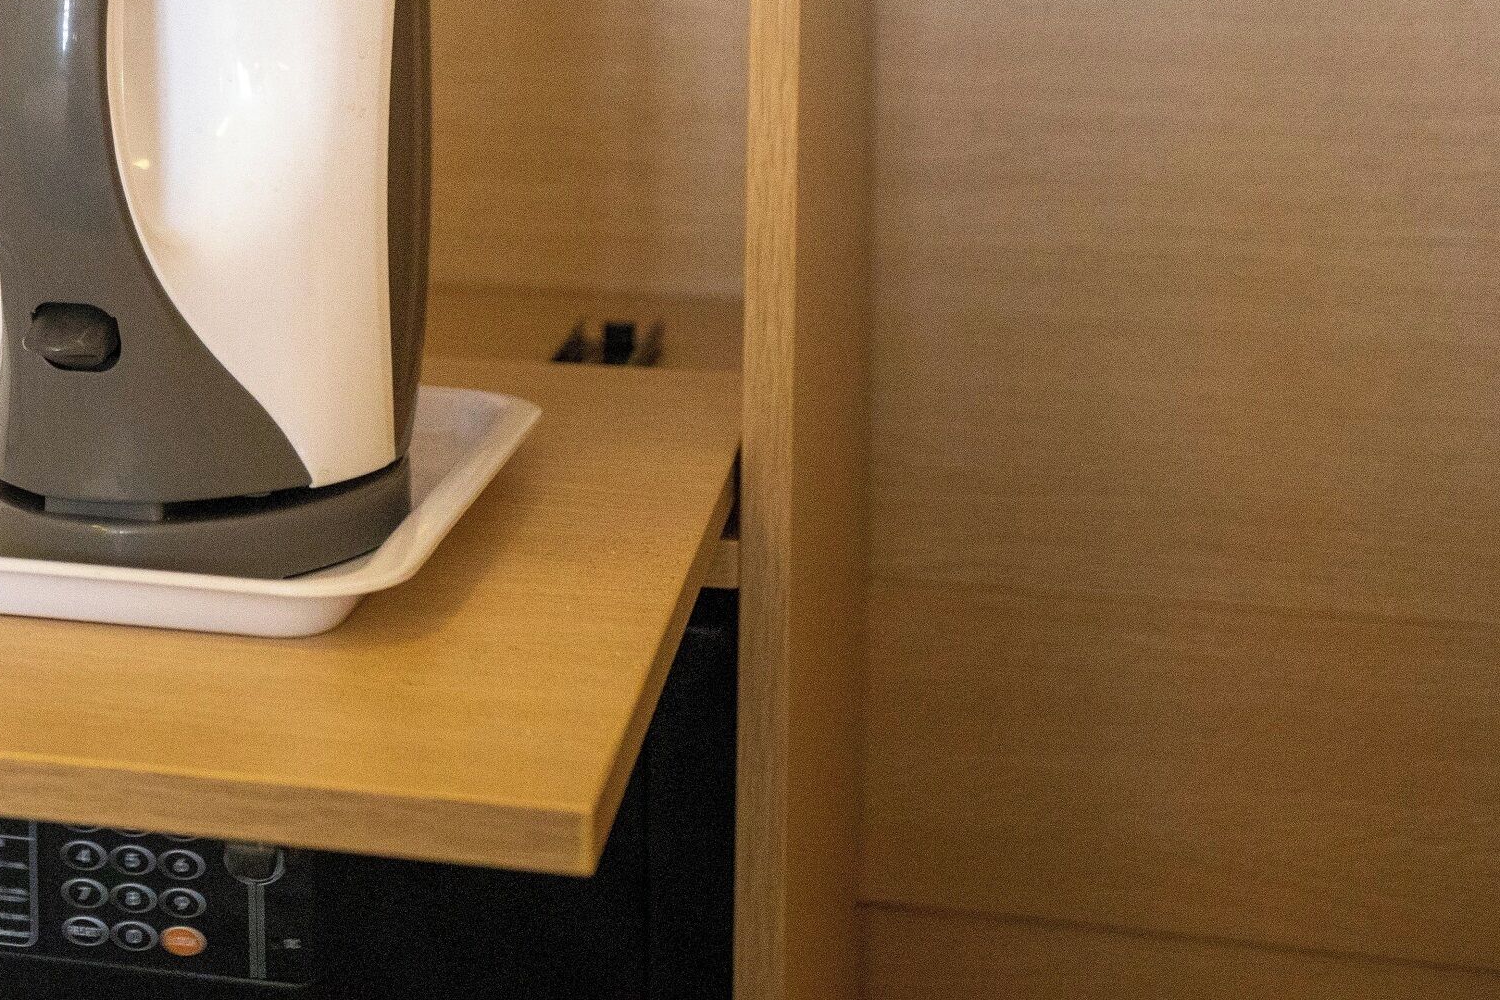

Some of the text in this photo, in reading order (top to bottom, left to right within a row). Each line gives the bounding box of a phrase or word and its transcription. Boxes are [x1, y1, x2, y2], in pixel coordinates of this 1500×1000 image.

[75, 848, 189, 873] 4 5 6
[77, 886, 190, 911] 7 8 9
